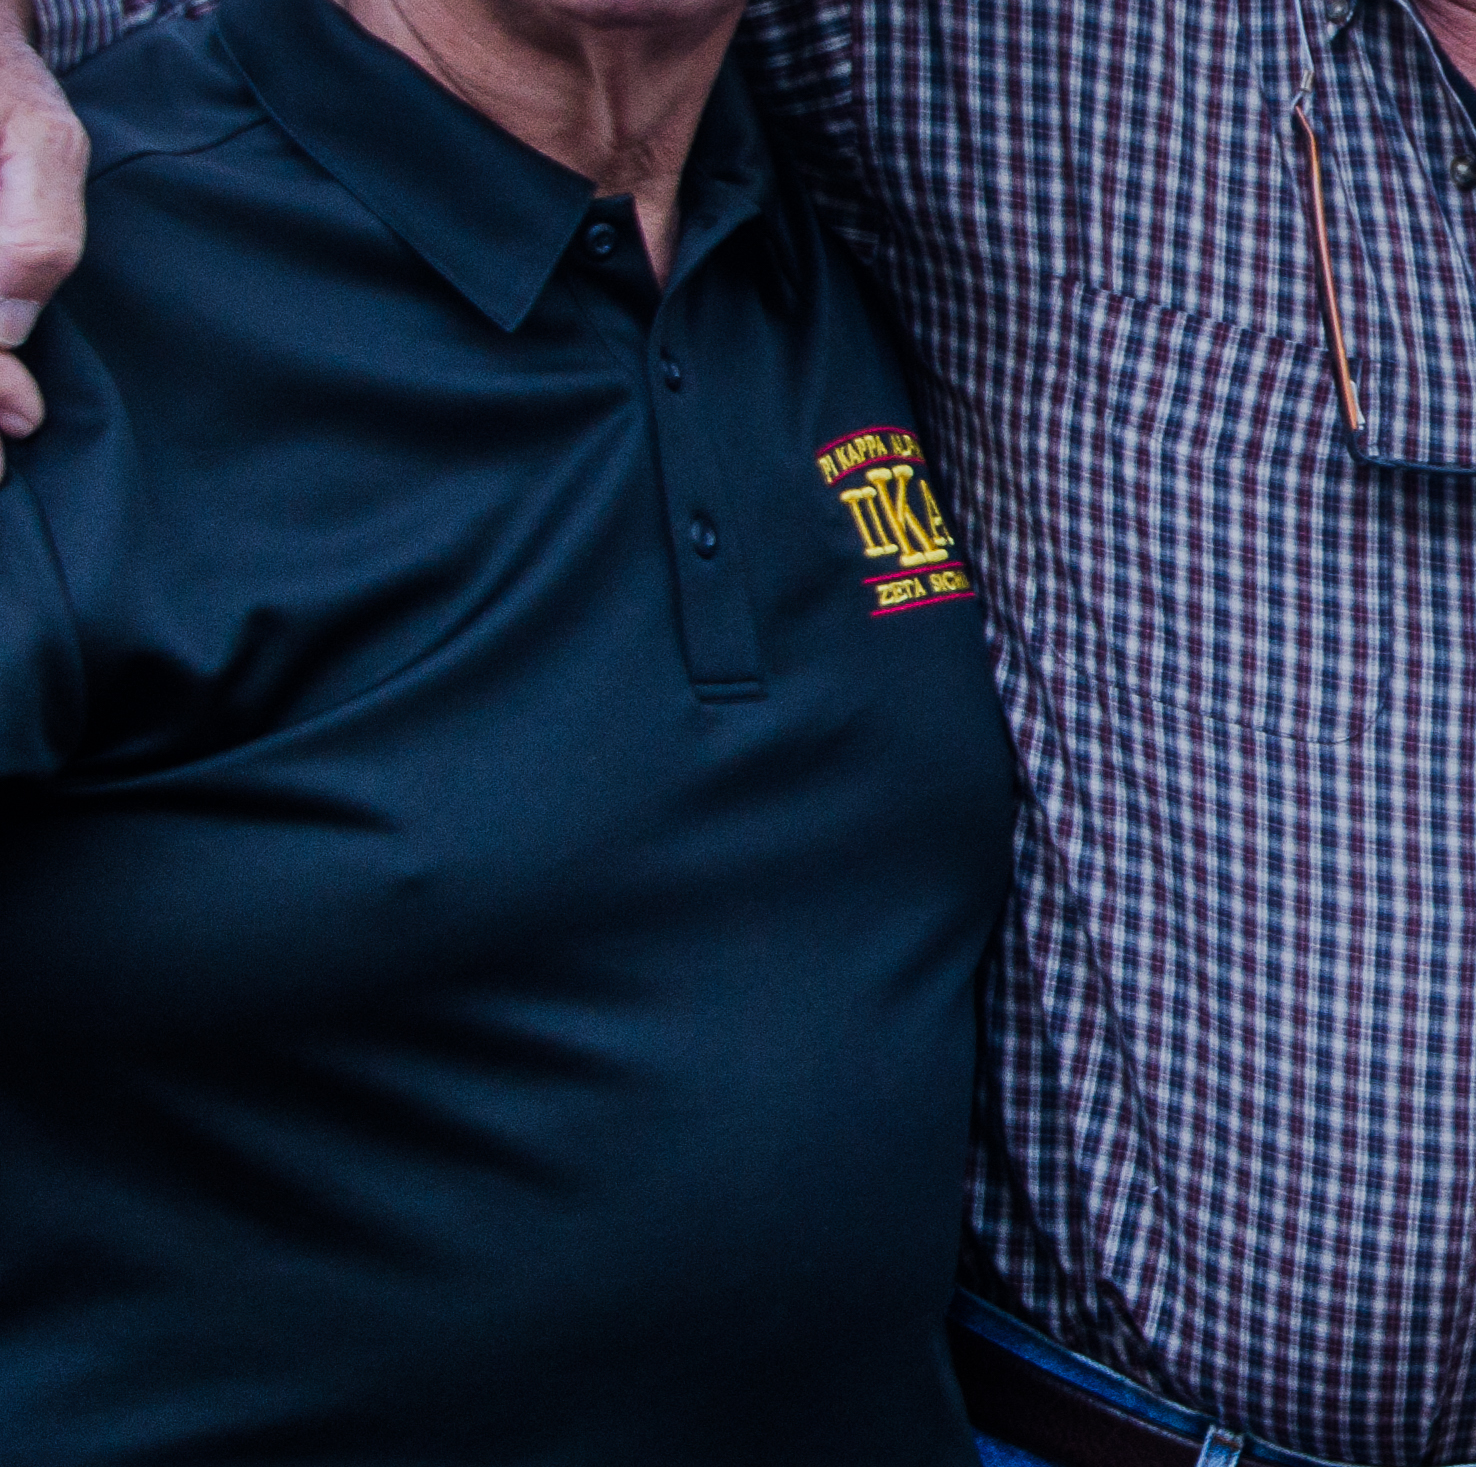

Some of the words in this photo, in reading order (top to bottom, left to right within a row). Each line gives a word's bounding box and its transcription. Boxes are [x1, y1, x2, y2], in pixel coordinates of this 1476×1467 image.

[818, 454, 839, 484] PI
[834, 434, 889, 471] KAPPA
[876, 577, 927, 606] ZETA
